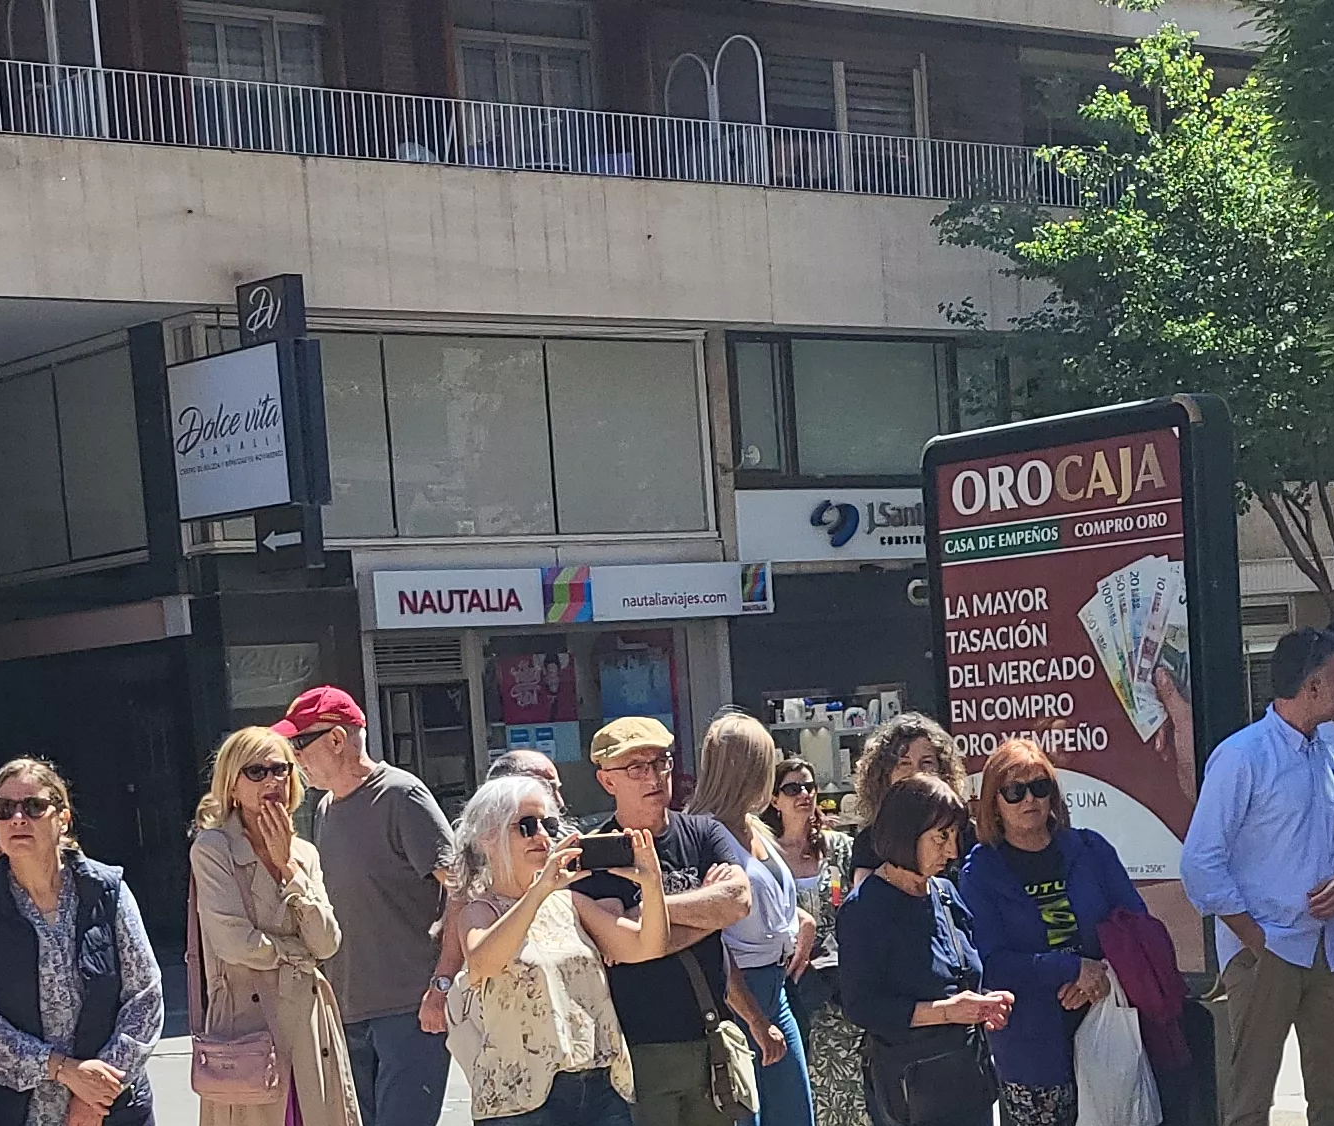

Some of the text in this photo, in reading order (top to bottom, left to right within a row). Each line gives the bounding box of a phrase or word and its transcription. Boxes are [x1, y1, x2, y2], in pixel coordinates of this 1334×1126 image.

[176, 393, 281, 457] Dolce vita
[951, 443, 1167, 516] OROCAJA
[1074, 511, 1168, 538] COMPRO ORO
[945, 525, 1059, 555] CASA DE EMPEÑOS
[398, 588, 523, 615] NAUTALIA
[622, 591, 727, 609] nautaliaviajes.com
[945, 587, 1049, 621] LA MAYOR
[946, 619, 1048, 655] TASACIÓN
[949, 654, 1096, 689] DEL MERCADO
[951, 693, 1075, 723] EN COMPRO
[954, 732, 998, 757] ORO
[1076, 791, 1108, 808] UNA
